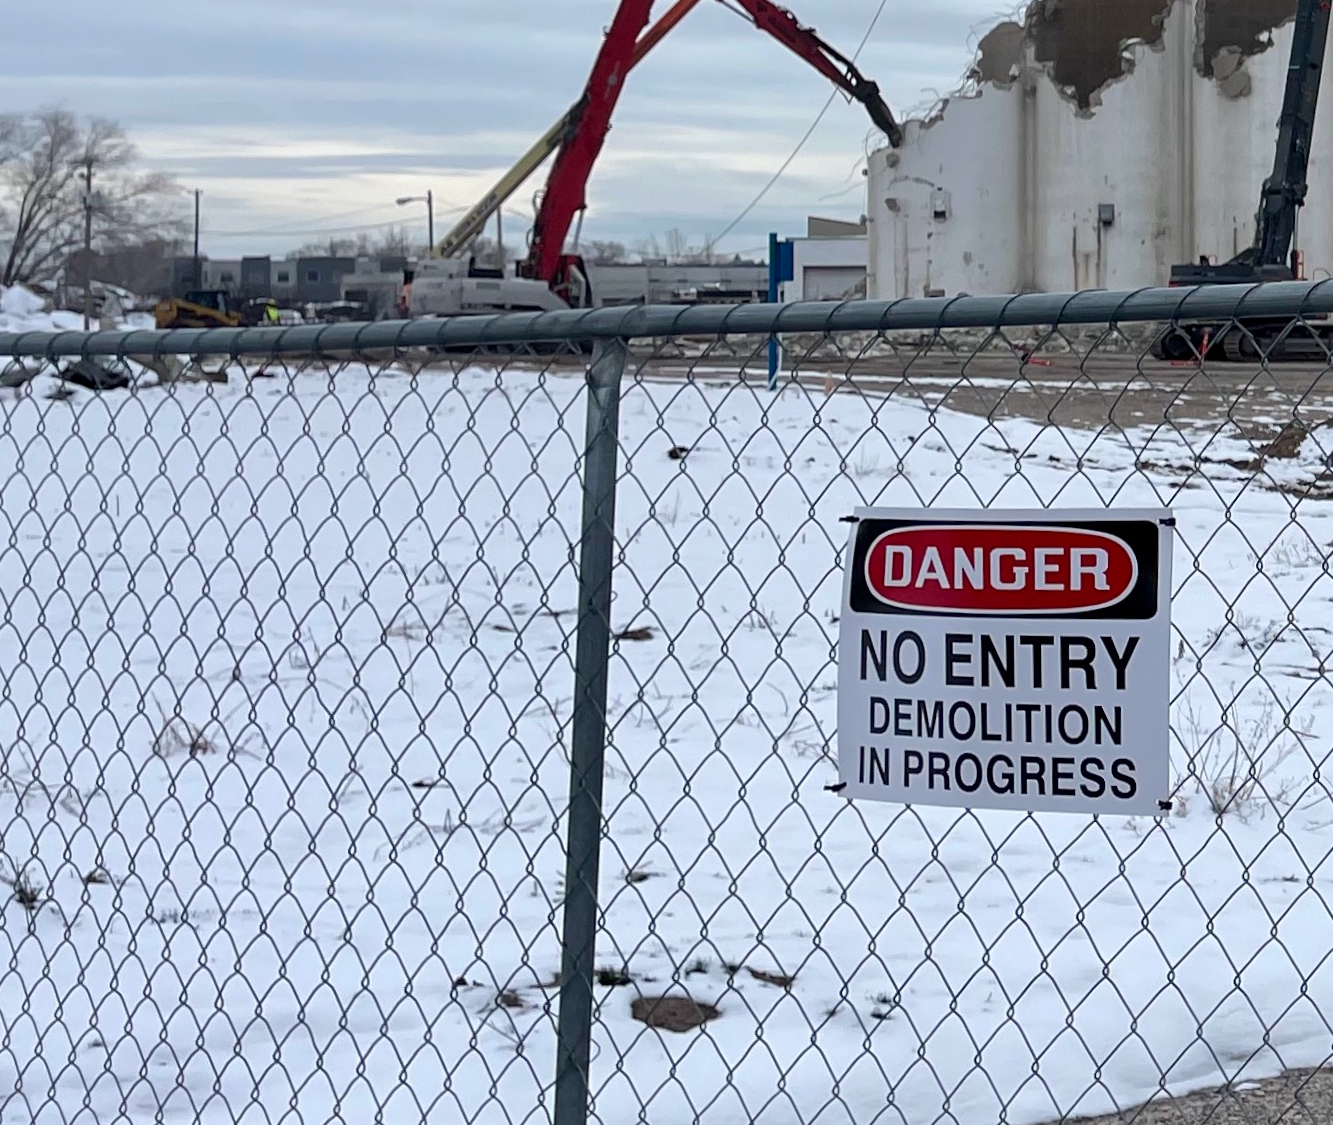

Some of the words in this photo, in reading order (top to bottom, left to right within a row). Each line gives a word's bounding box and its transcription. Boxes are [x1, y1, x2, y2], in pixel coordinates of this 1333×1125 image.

[884, 544, 1110, 591] DANGER
[860, 629, 926, 684] NO
[945, 633, 1140, 690] ENTRY
[869, 696, 1122, 745] DEMOLITION
[859, 746, 890, 785] IN
[903, 749, 1137, 799] PROGRESS
